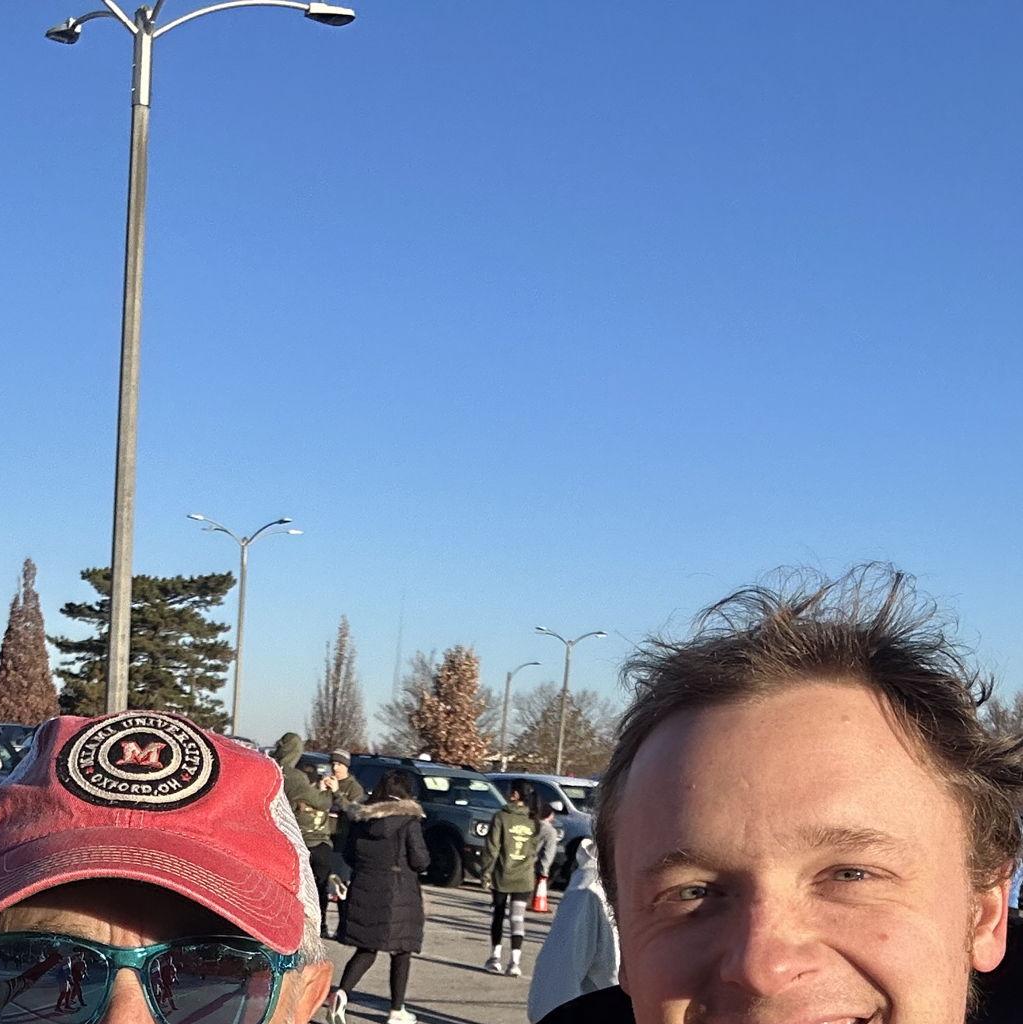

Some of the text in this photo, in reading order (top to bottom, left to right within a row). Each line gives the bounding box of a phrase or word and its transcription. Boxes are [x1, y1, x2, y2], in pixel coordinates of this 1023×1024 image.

[80, 717, 199, 775] MIAMI UNIVERSITY
[116, 740, 167, 768] M
